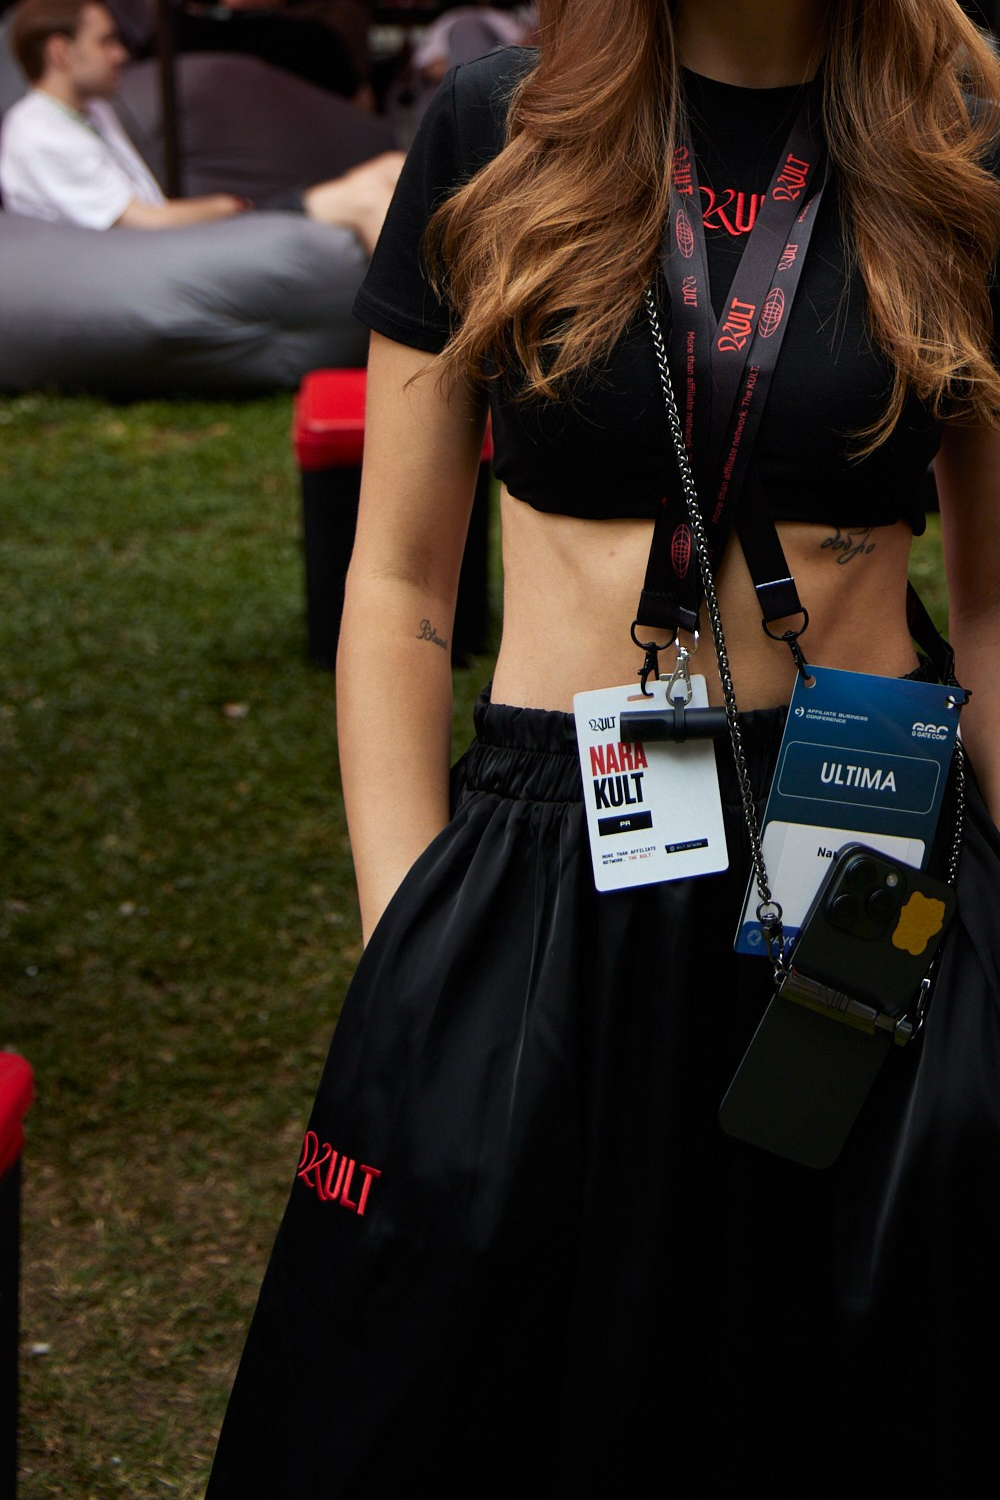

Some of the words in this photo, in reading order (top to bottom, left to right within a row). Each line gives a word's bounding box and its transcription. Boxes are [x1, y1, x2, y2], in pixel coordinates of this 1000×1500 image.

[717, 297, 757, 352] KULT
[687, 331, 696, 354] More
[686, 355, 696, 377] than
[742, 389, 754, 408] The
[588, 716, 616, 731] KULT
[805, 714, 847, 724] CONFERENCE
[807, 708, 837, 717] AFFILIATE
[589, 742, 648, 776] NARA
[820, 762, 897, 792] ULTIMA
[593, 772, 644, 809] KULT
[630, 846, 657, 855] AFFILIATE
[297, 1130, 382, 1215] KULT
